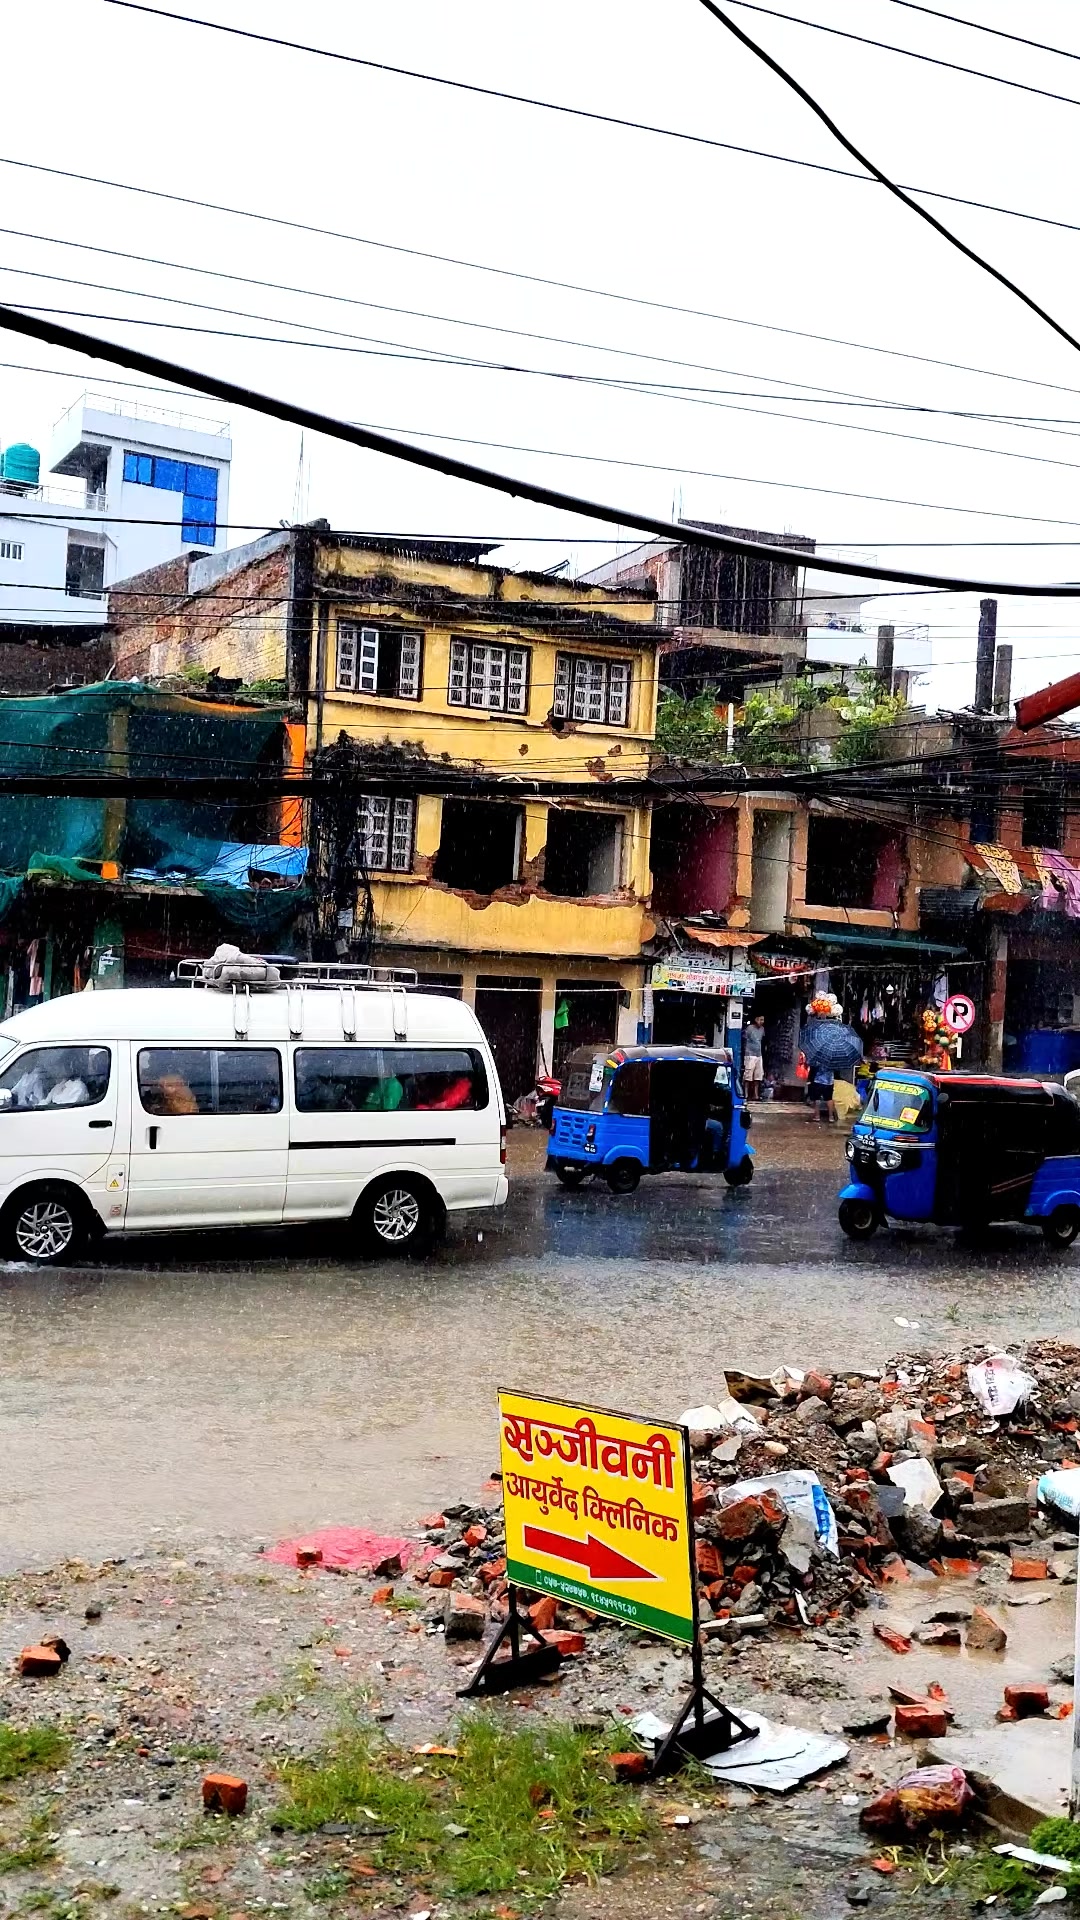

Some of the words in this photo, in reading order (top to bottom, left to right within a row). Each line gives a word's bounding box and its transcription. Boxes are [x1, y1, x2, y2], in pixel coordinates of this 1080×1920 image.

[952, 1002, 969, 1023] P
[505, 1472, 579, 1521] आयुर्वेद
[582, 1485, 680, 1542] क्लिनिक
